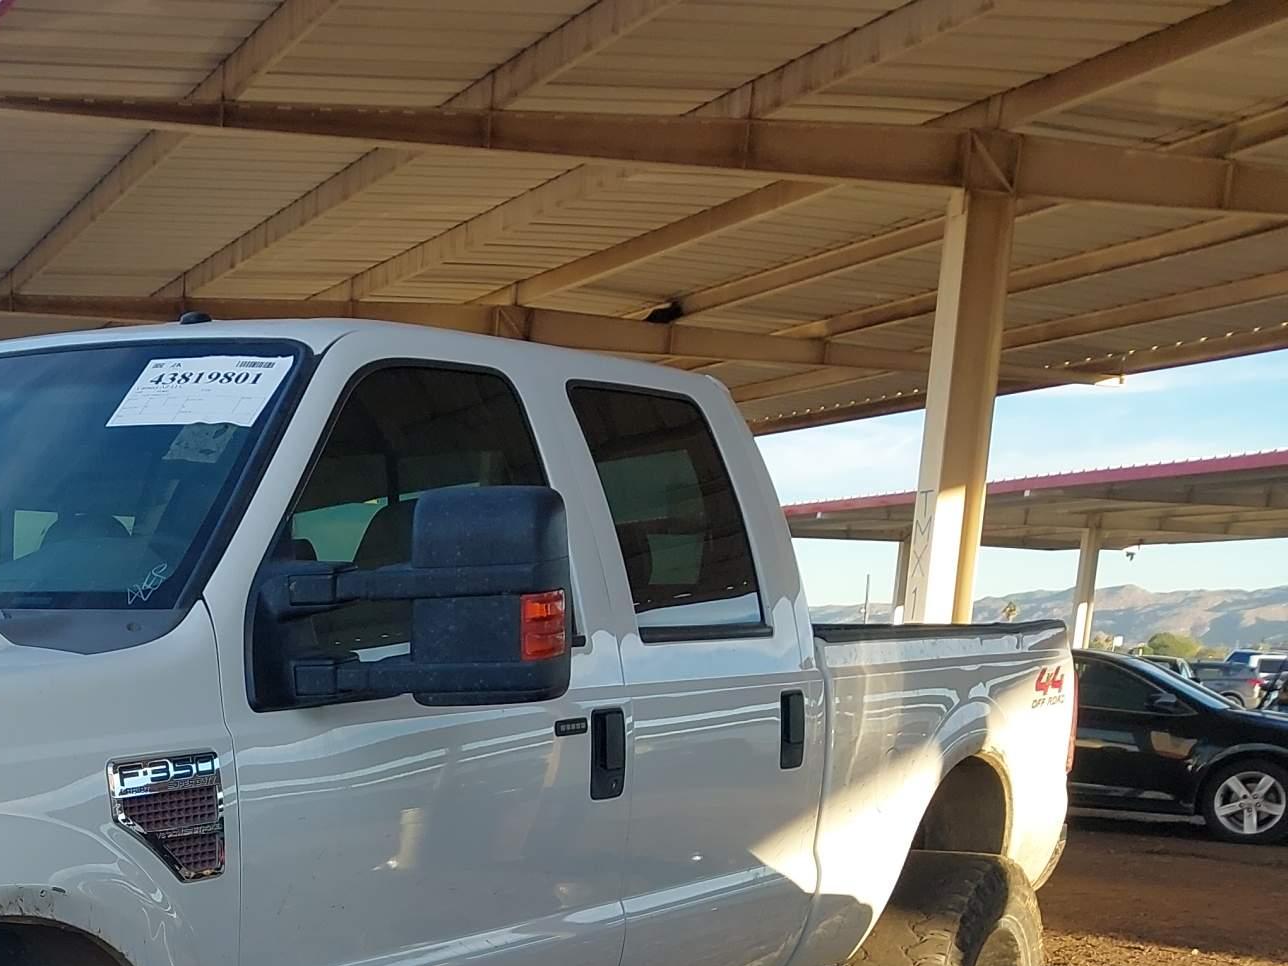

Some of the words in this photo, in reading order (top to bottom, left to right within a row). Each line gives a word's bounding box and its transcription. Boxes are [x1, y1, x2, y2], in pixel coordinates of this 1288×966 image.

[149, 371, 264, 386] 43819801
[1032, 698, 1046, 709] OFF
[117, 754, 216, 787] F-350
